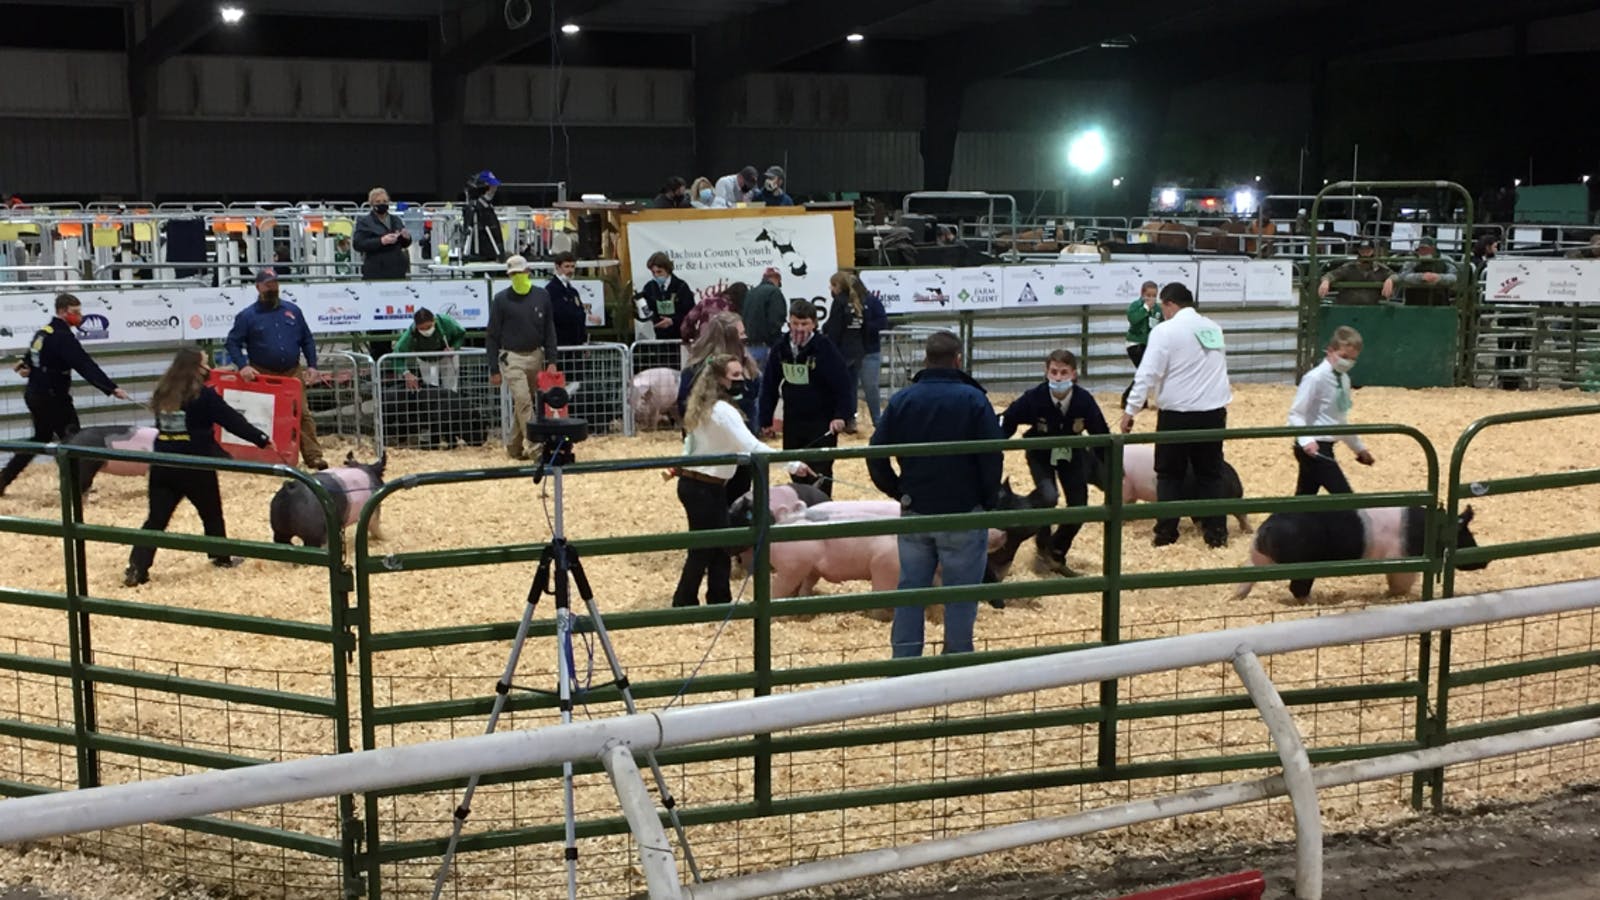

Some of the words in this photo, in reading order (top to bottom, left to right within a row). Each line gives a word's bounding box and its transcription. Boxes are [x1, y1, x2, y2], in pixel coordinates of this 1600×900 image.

[703, 247, 740, 259] County
[742, 244, 772, 256] Youth
[685, 260, 696, 270] &
[699, 257, 744, 270] Livestock
[747, 257, 773, 268] Show
[126, 317, 169, 328] oneblood
[206, 314, 235, 322] GATO
